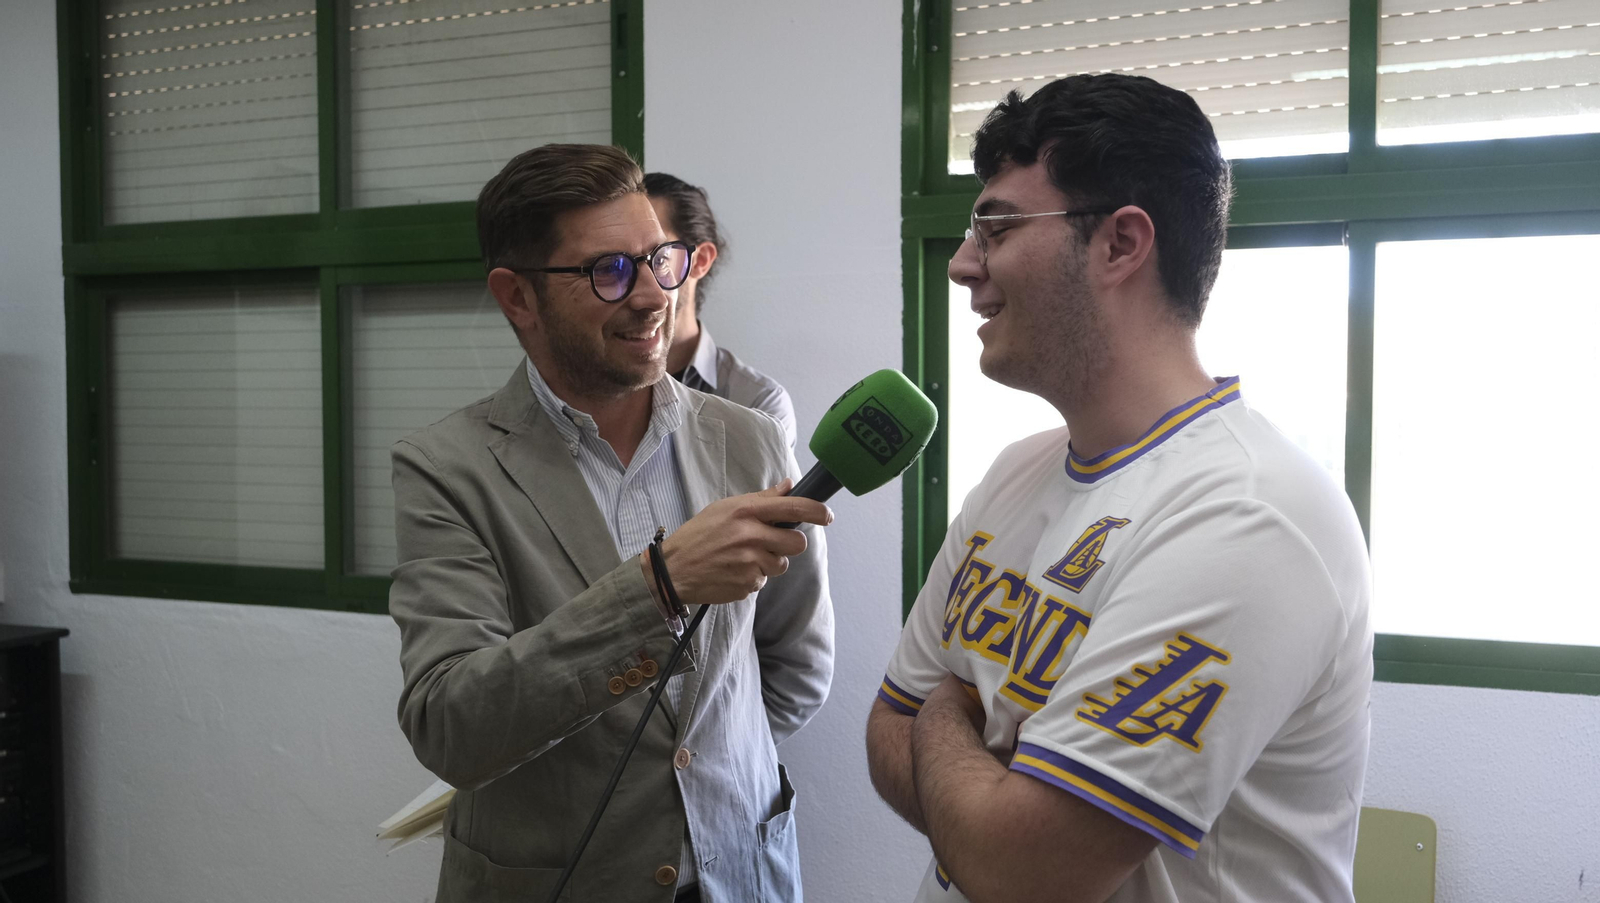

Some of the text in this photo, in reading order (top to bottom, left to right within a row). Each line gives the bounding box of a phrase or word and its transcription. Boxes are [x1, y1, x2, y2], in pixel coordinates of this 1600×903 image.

[855, 422, 890, 455] CERO
[866, 408, 900, 445] ONDA
[941, 530, 1092, 692] LEGND
[1075, 631, 1231, 753] LA
